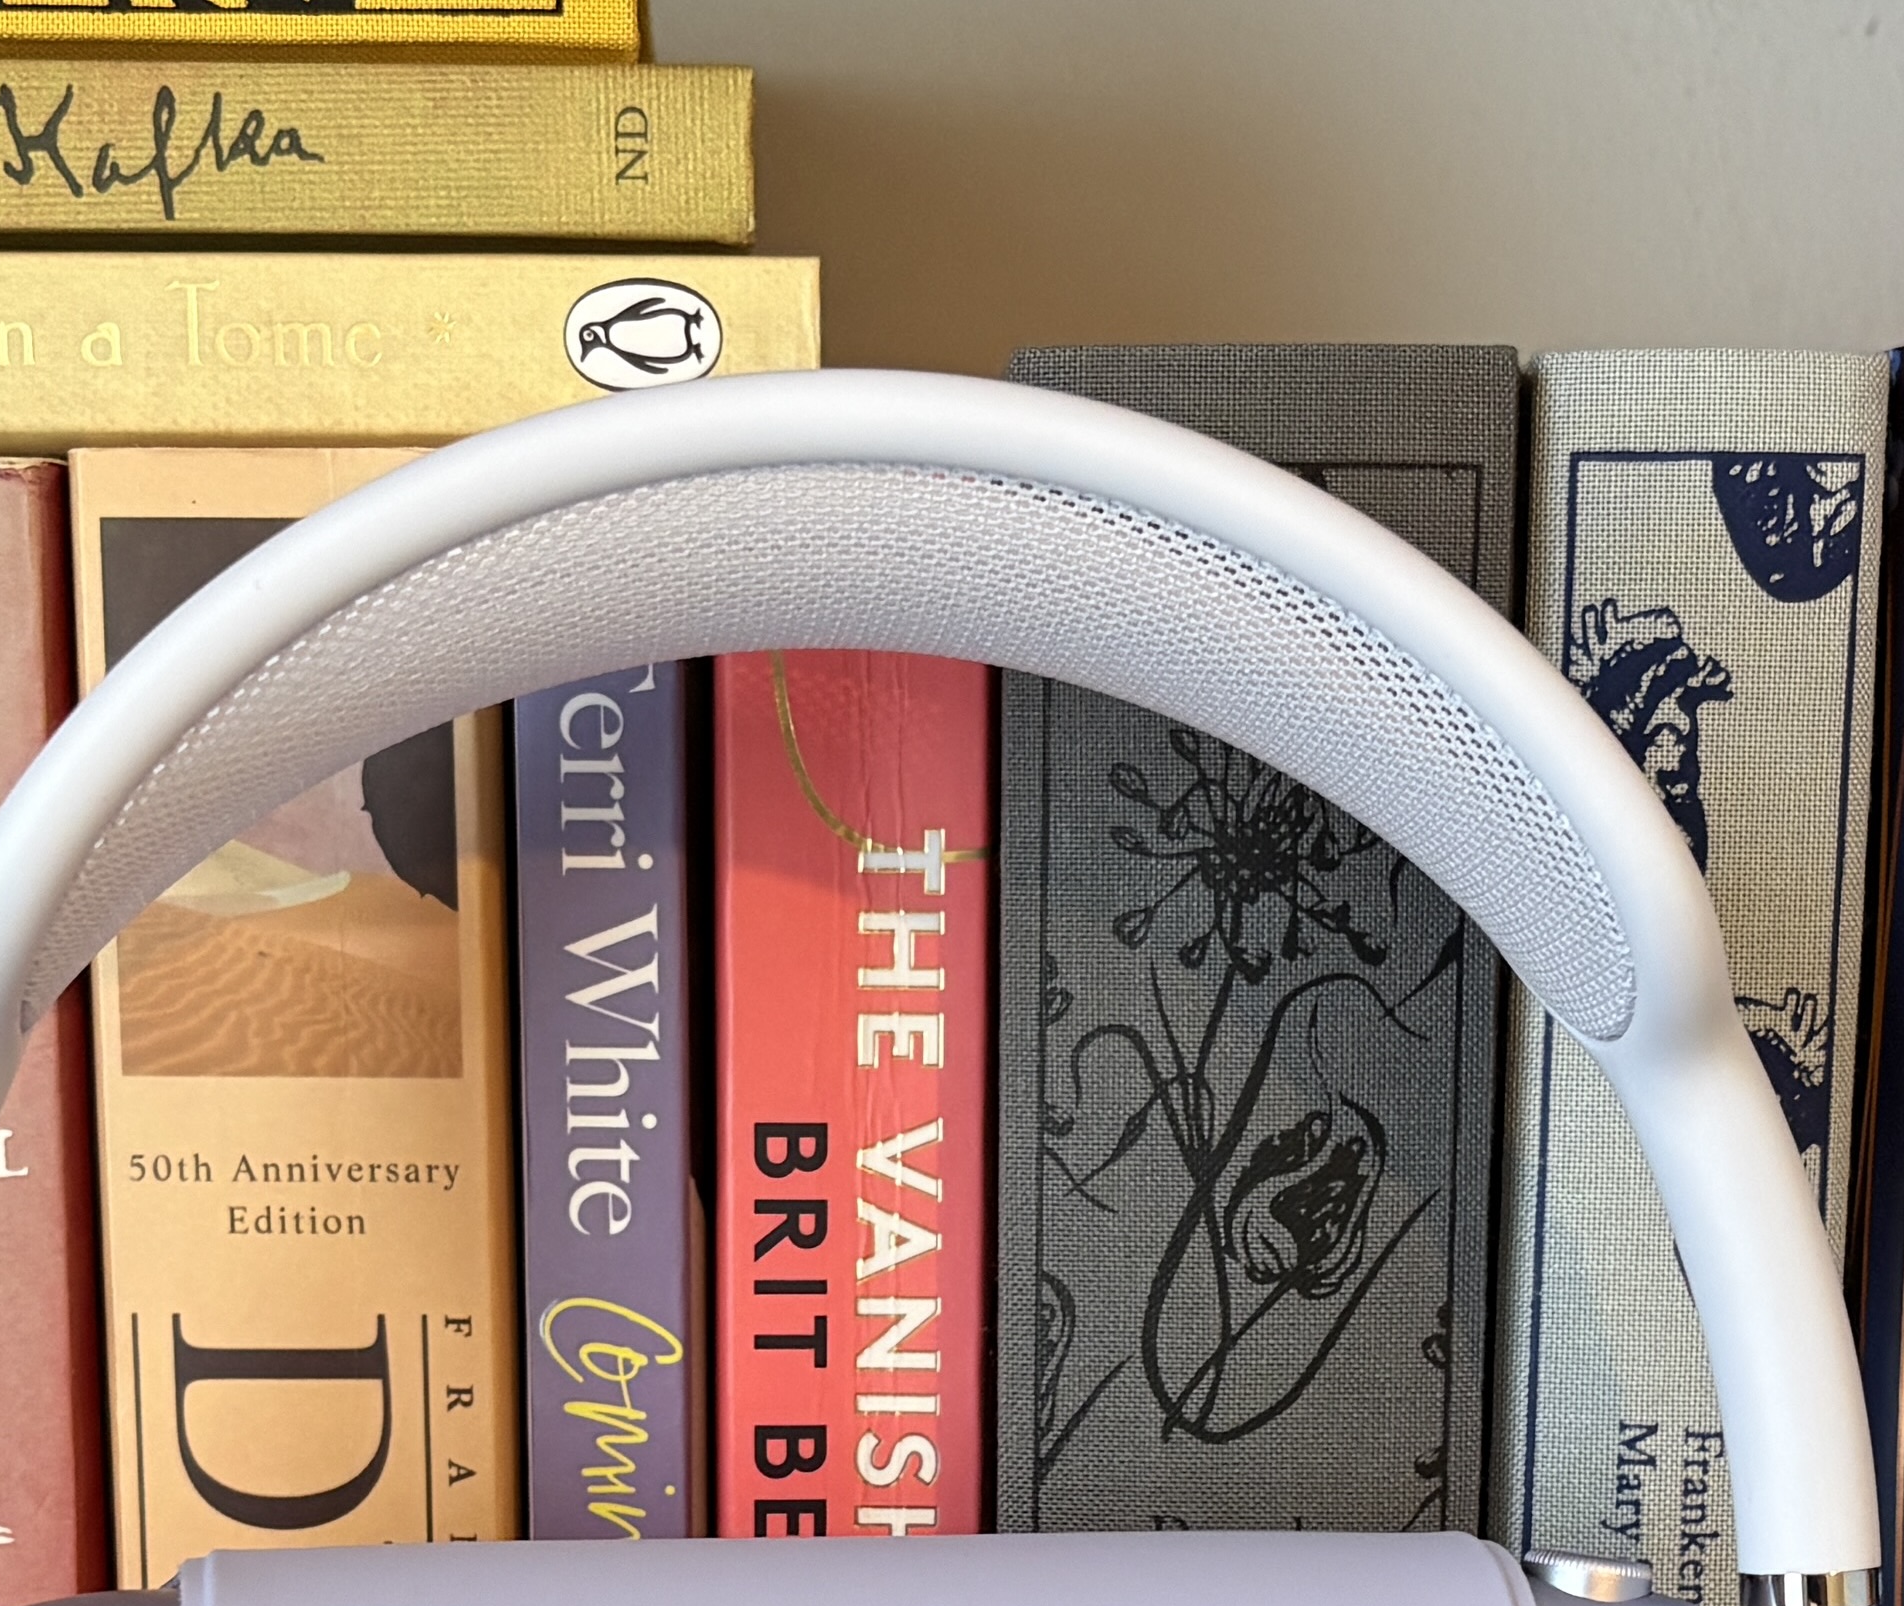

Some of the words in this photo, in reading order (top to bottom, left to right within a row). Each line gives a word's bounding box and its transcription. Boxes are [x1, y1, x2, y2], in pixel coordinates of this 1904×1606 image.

[615, 105, 649, 184] ND
[81, 326, 124, 369] a
[857, 828, 947, 1069] THE
[562, 902, 660, 1236] White
[128, 1153, 213, 1183] 50th
[231, 1154, 461, 1191] Anniversary
[227, 1206, 367, 1236] Edition
[752, 1122, 829, 1369] BRIT
[1600, 1422, 1658, 1544] Mary
[1677, 1427, 1725, 1605] Franken
